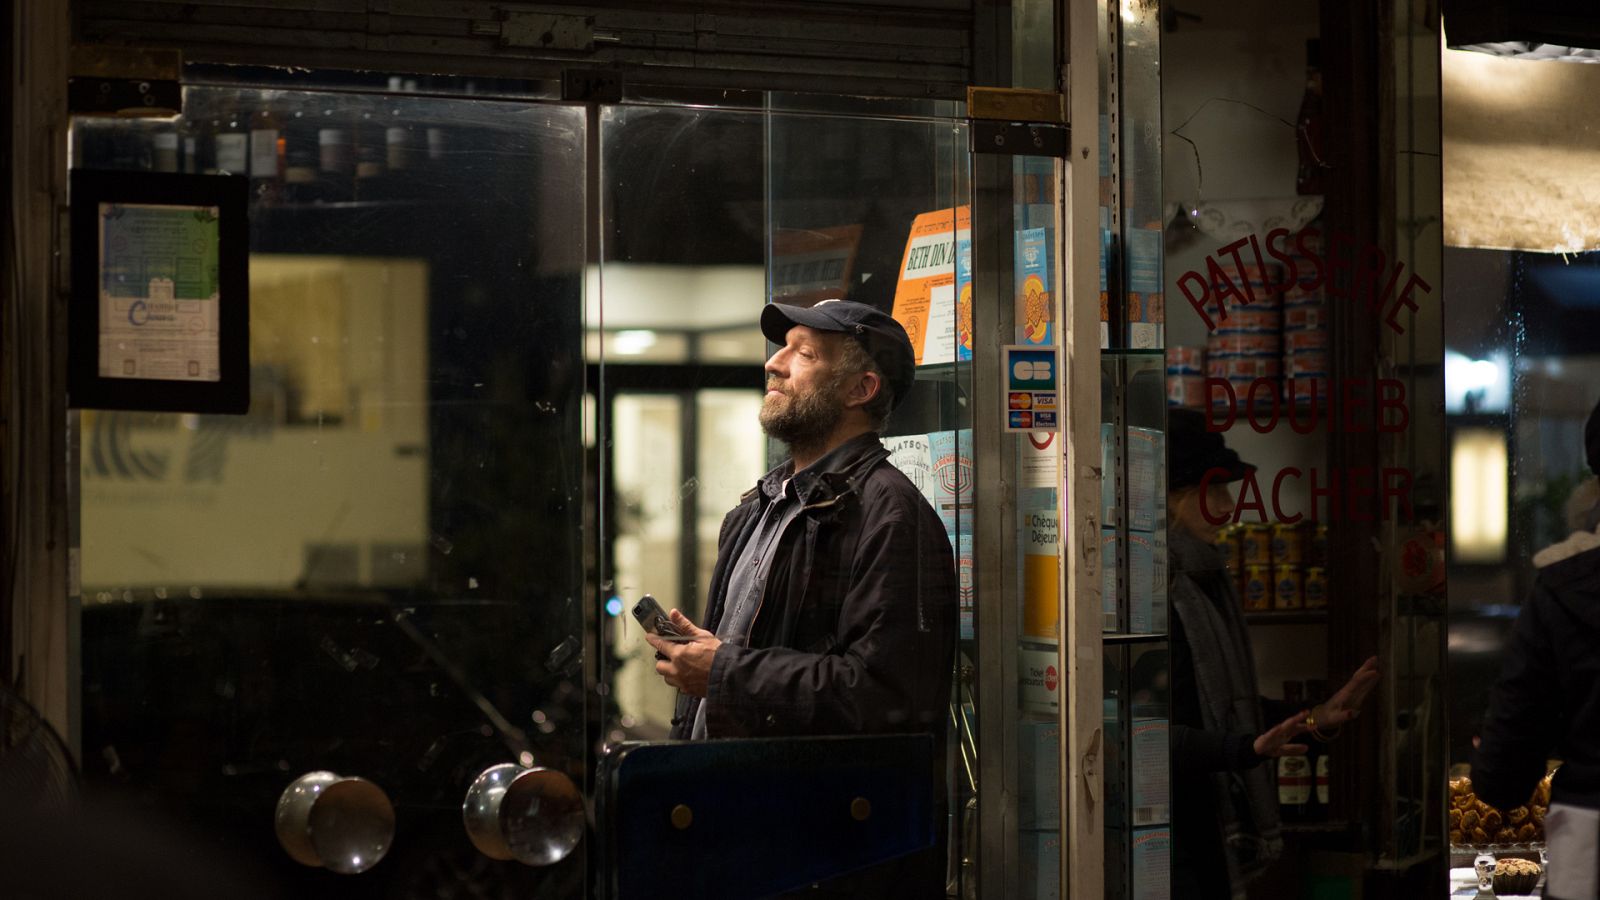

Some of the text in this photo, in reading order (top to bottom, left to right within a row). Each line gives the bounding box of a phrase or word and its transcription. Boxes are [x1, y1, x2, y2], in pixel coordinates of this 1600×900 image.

[907, 245, 931, 270] BETH
[930, 242, 949, 267] DIN
[1176, 228, 1432, 335] PATISSERIE
[1204, 377, 1409, 434] DOUIEB
[890, 440, 928, 456] MATSOT
[1199, 466, 1414, 526] CACHER
